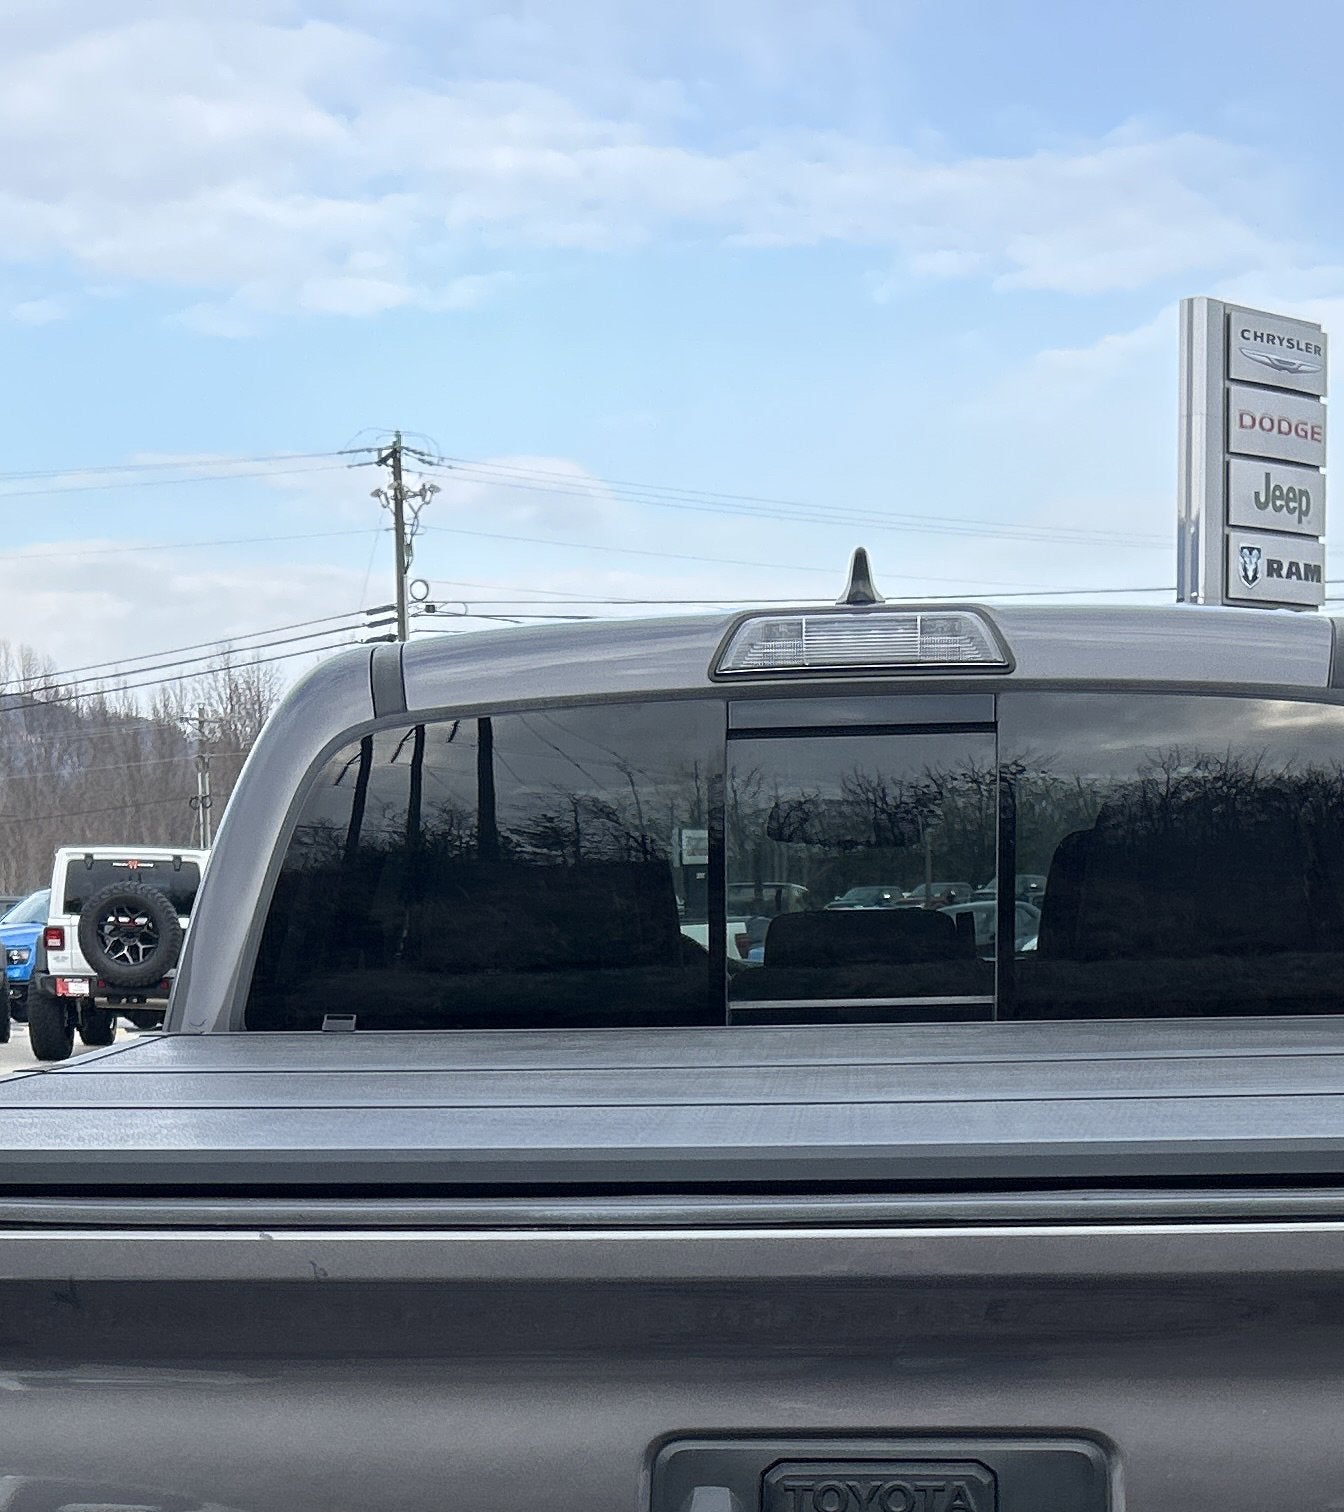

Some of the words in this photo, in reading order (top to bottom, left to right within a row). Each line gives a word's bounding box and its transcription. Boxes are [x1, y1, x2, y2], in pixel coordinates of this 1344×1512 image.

[1240, 328, 1322, 357] CHRYSLER
[1238, 410, 1322, 443] DODGE
[1254, 472, 1311, 524] Jeep
[1266, 558, 1322, 584] RAM
